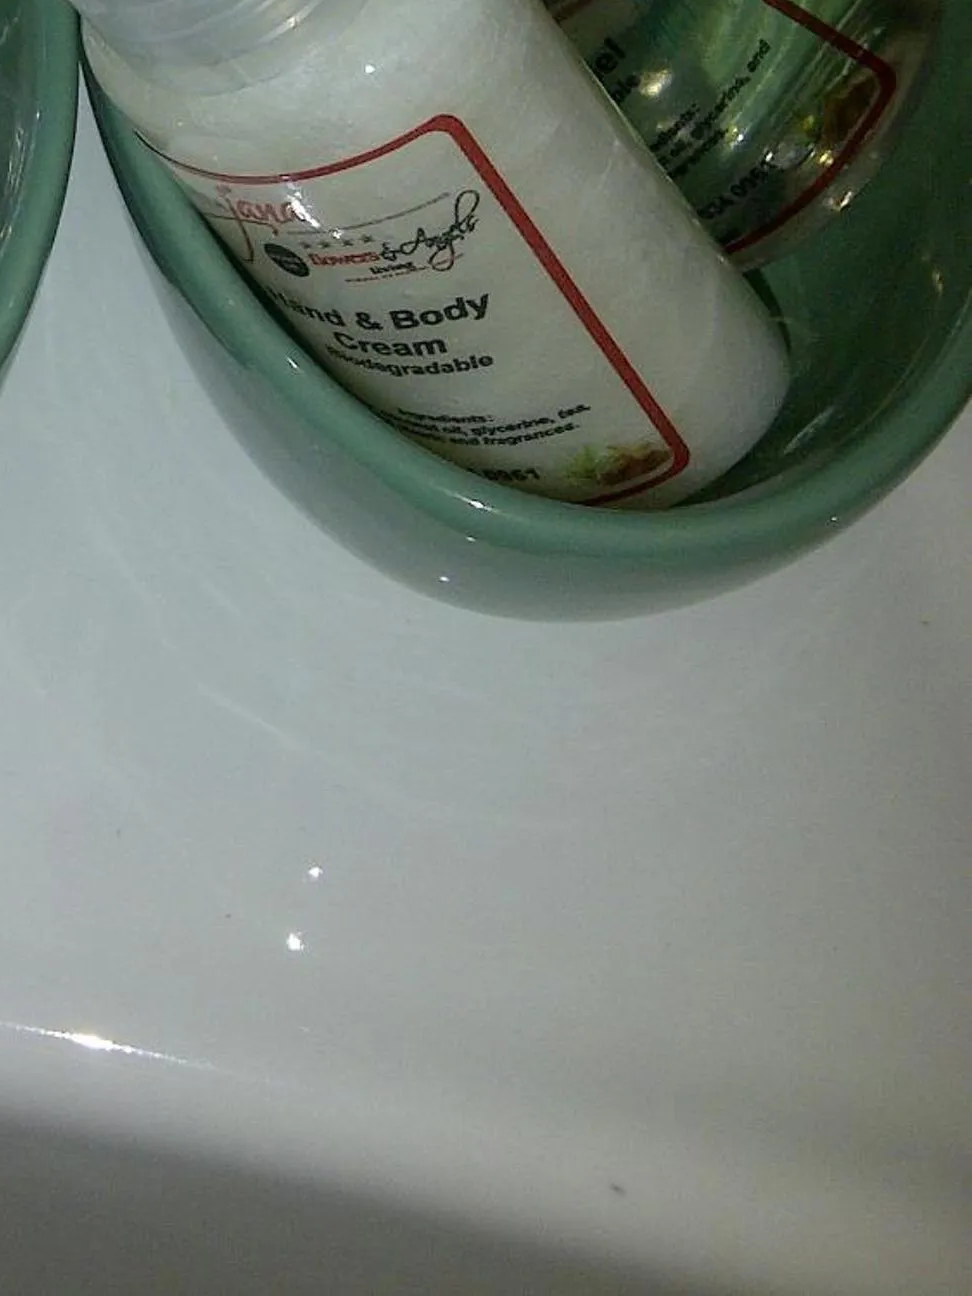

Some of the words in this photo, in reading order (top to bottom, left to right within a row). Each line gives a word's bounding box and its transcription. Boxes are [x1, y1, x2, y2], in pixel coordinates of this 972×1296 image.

[354, 310, 384, 331] &
[389, 292, 490, 331] Body
[332, 330, 448, 357] Cream
